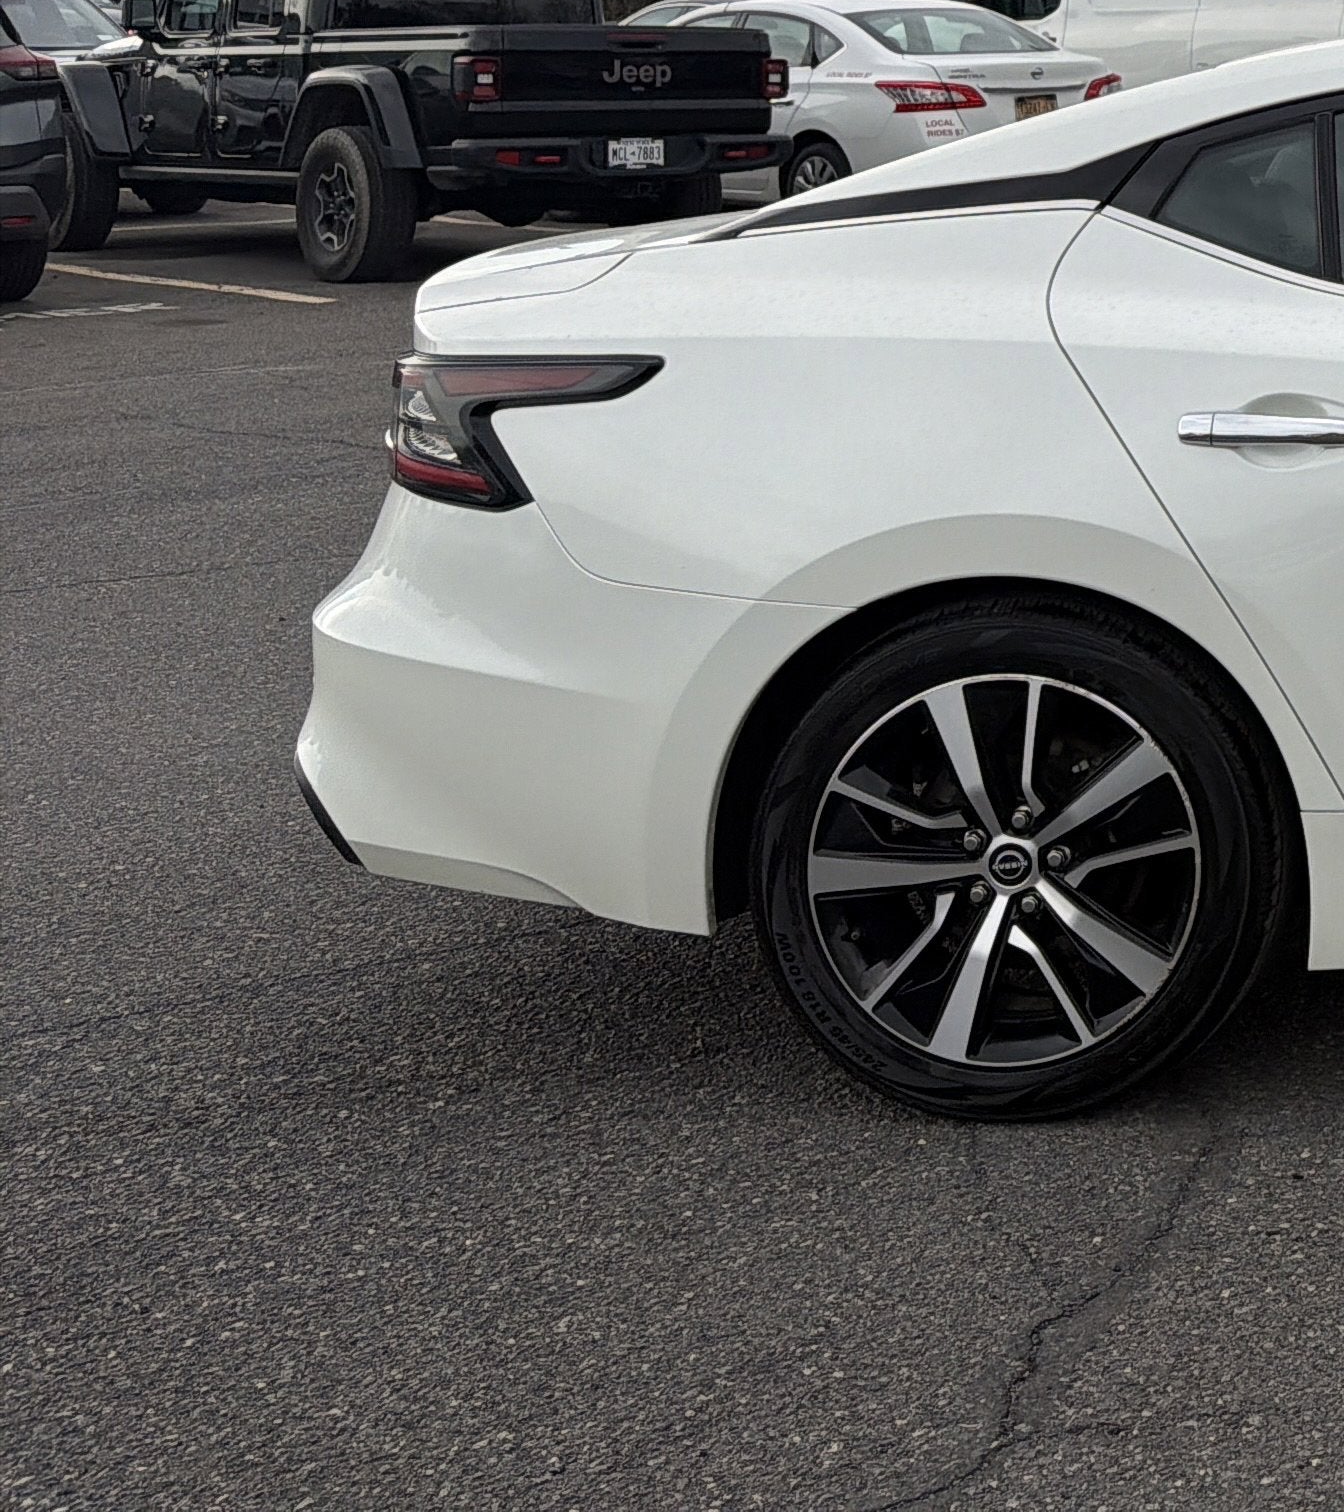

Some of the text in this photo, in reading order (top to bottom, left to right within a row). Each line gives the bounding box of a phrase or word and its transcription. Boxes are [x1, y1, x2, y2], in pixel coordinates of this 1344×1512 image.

[602, 59, 672, 88] Jeep
[925, 119, 955, 128] LOCAL
[927, 128, 953, 137] RIDES
